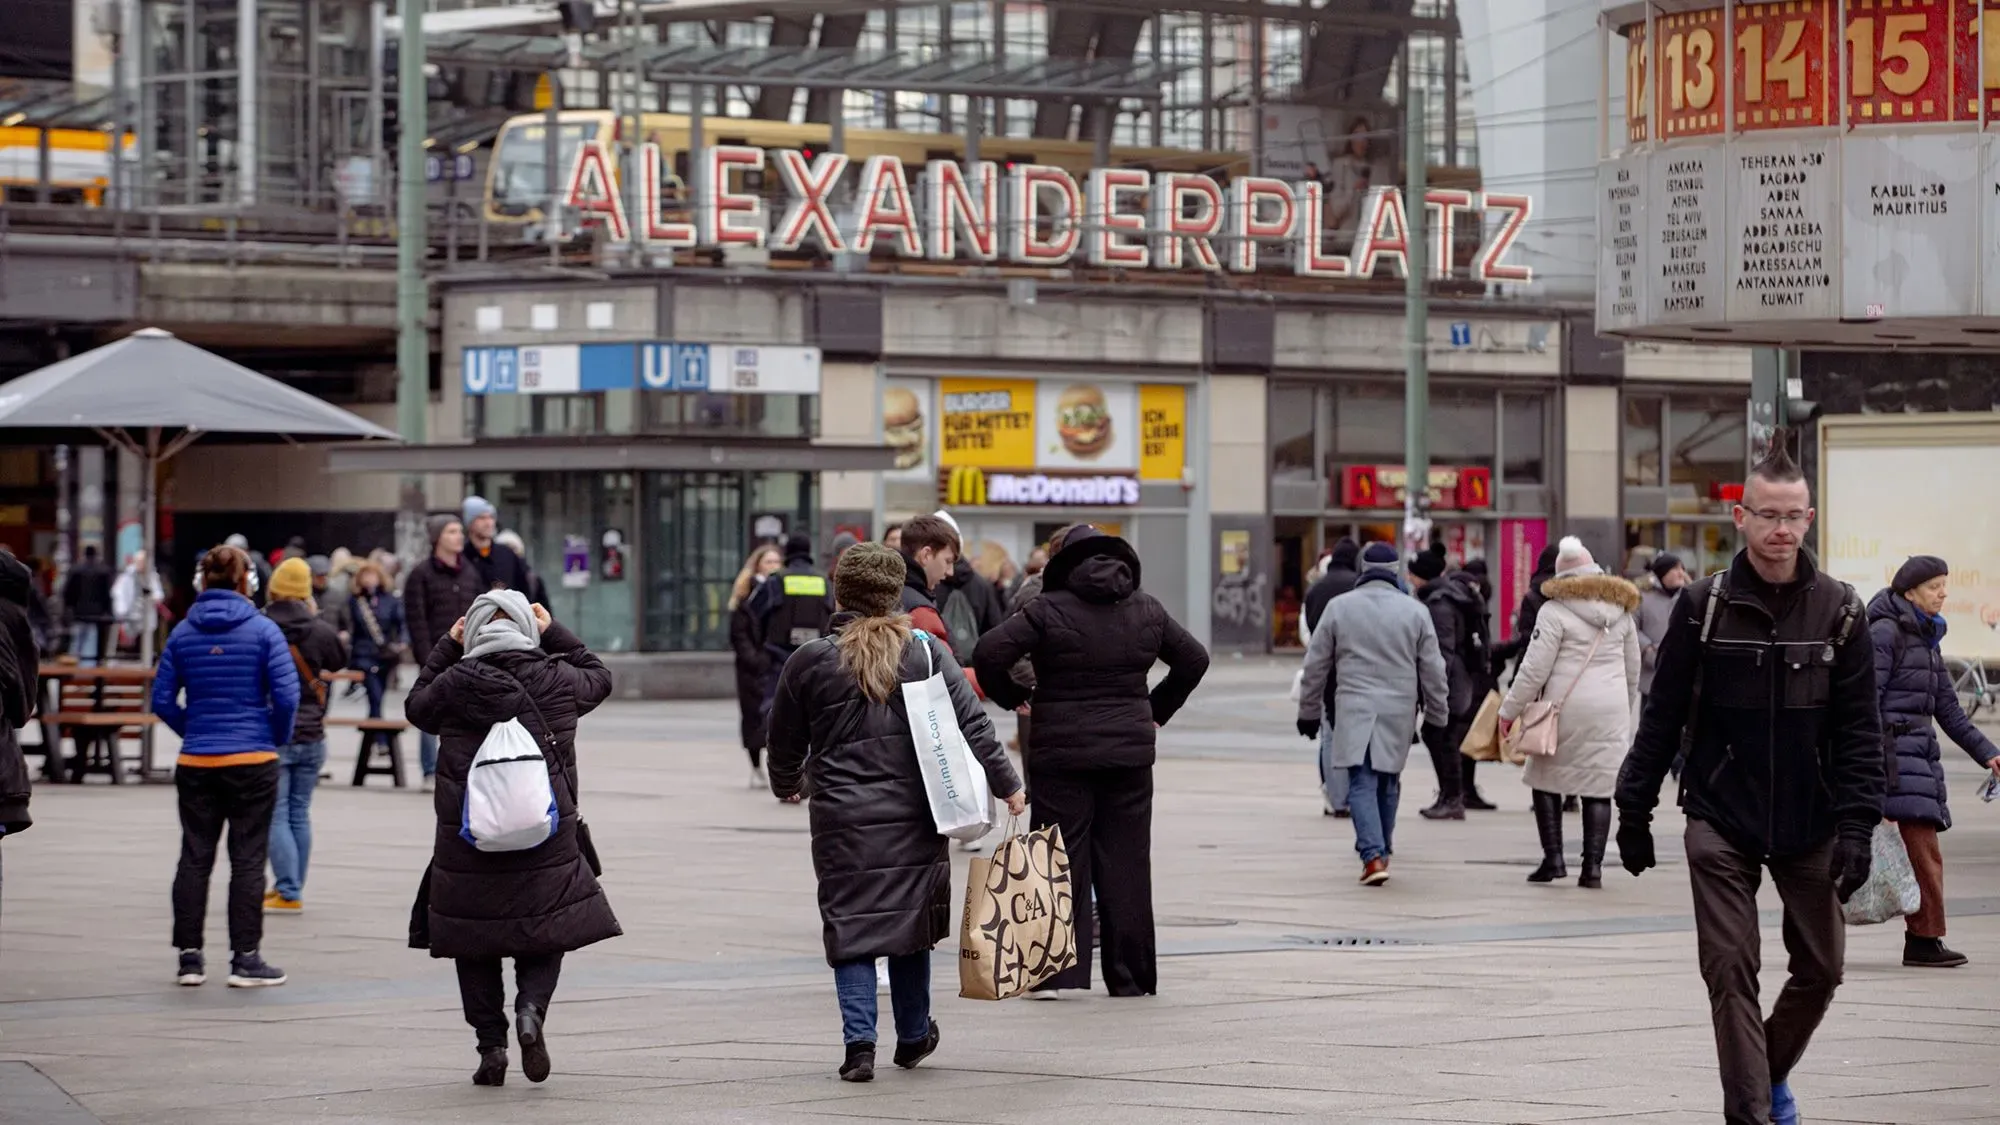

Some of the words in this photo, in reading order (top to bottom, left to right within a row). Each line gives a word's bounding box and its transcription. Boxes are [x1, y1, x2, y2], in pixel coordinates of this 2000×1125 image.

[1737, 20, 1806, 102] 14
[1846, 13, 1930, 97] 15
[1666, 28, 1714, 111] 13
[1667, 160, 1703, 176] ANKARA
[1741, 154, 1796, 169] TEHERAN
[1666, 177, 1703, 193] ISTANBUL
[1760, 171, 1806, 185] BAGDAD
[1767, 189, 1800, 201] ADEN
[1871, 184, 1916, 198] KABUL
[1672, 194, 1698, 209] ATHEN
[1873, 201, 1947, 216] MAURITIUS
[558, 139, 1533, 284] ALEXANDERPLATZ
[1667, 213, 1680, 226] TEL
[1683, 211, 1702, 225] AVIV
[1760, 207, 1804, 220] SANAA
[1662, 227, 1707, 244] JERUSALEM
[1743, 224, 1778, 239] ADDIS
[1784, 222, 1823, 236] ABEBA
[1670, 246, 1697, 260] BEIRUT
[1743, 240, 1822, 255] MOGADISCHU
[1663, 261, 1706, 277] DAMASKUS
[1743, 256, 1822, 272] DARESSALAM
[1671, 279, 1696, 293] KAIRO
[1736, 273, 1830, 290] ANTANANARIVO
[1664, 296, 1704, 311] KAPSTADT
[1761, 292, 1804, 306] KUWAIT
[465, 350, 490, 391] U
[643, 345, 672, 388] U
[987, 474, 1140, 503] McDonald's
[1828, 532, 1883, 559] ultur
[926, 709, 960, 800] primark.com
[1011, 887, 1048, 925] C&A
